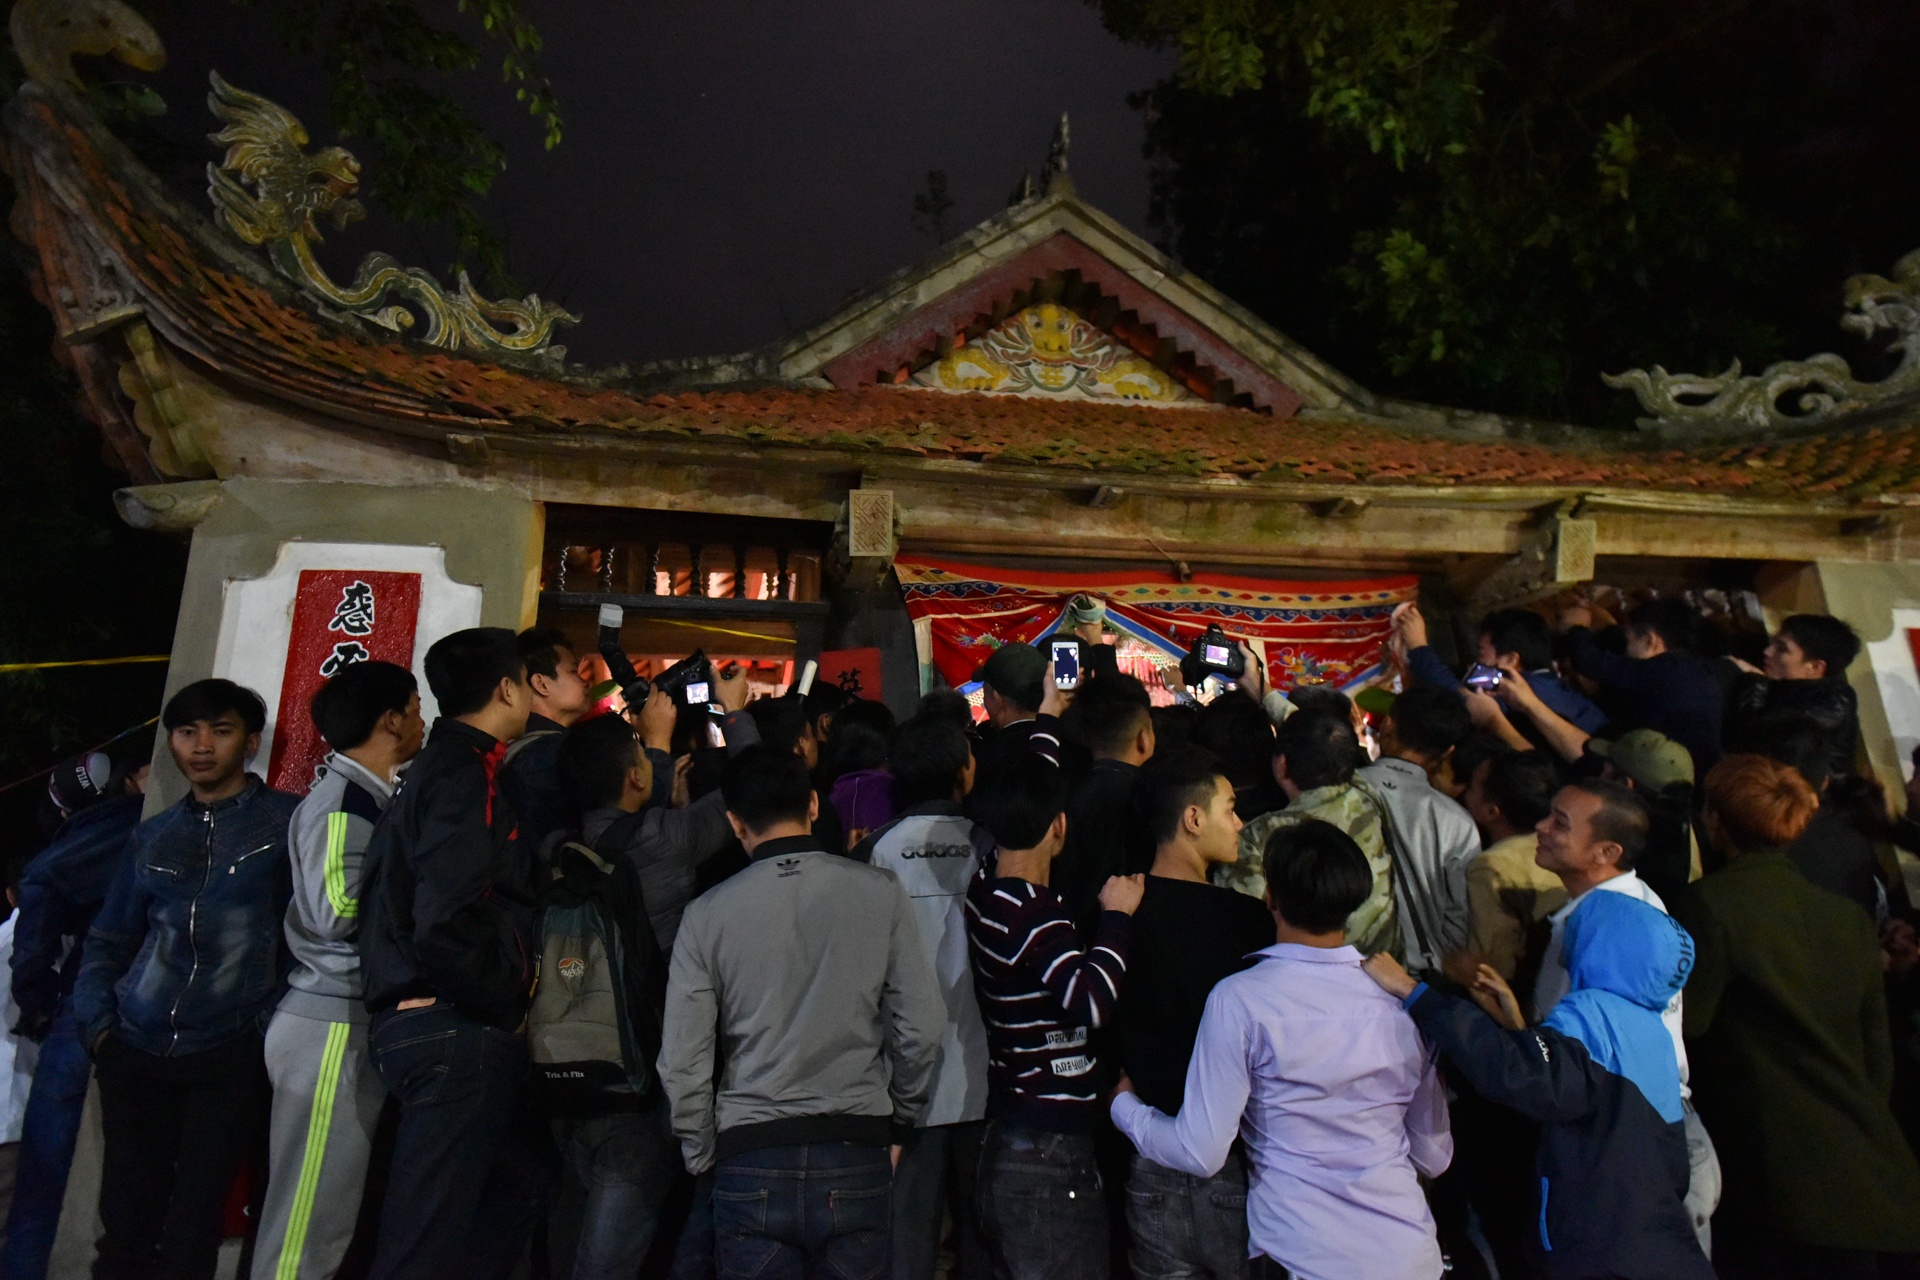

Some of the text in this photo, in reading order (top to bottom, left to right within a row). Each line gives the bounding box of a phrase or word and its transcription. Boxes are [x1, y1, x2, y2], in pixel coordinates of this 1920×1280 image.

[901, 843, 971, 860] adidas
[544, 1071, 561, 1079] Trix
[570, 1070, 585, 1078] Flix
